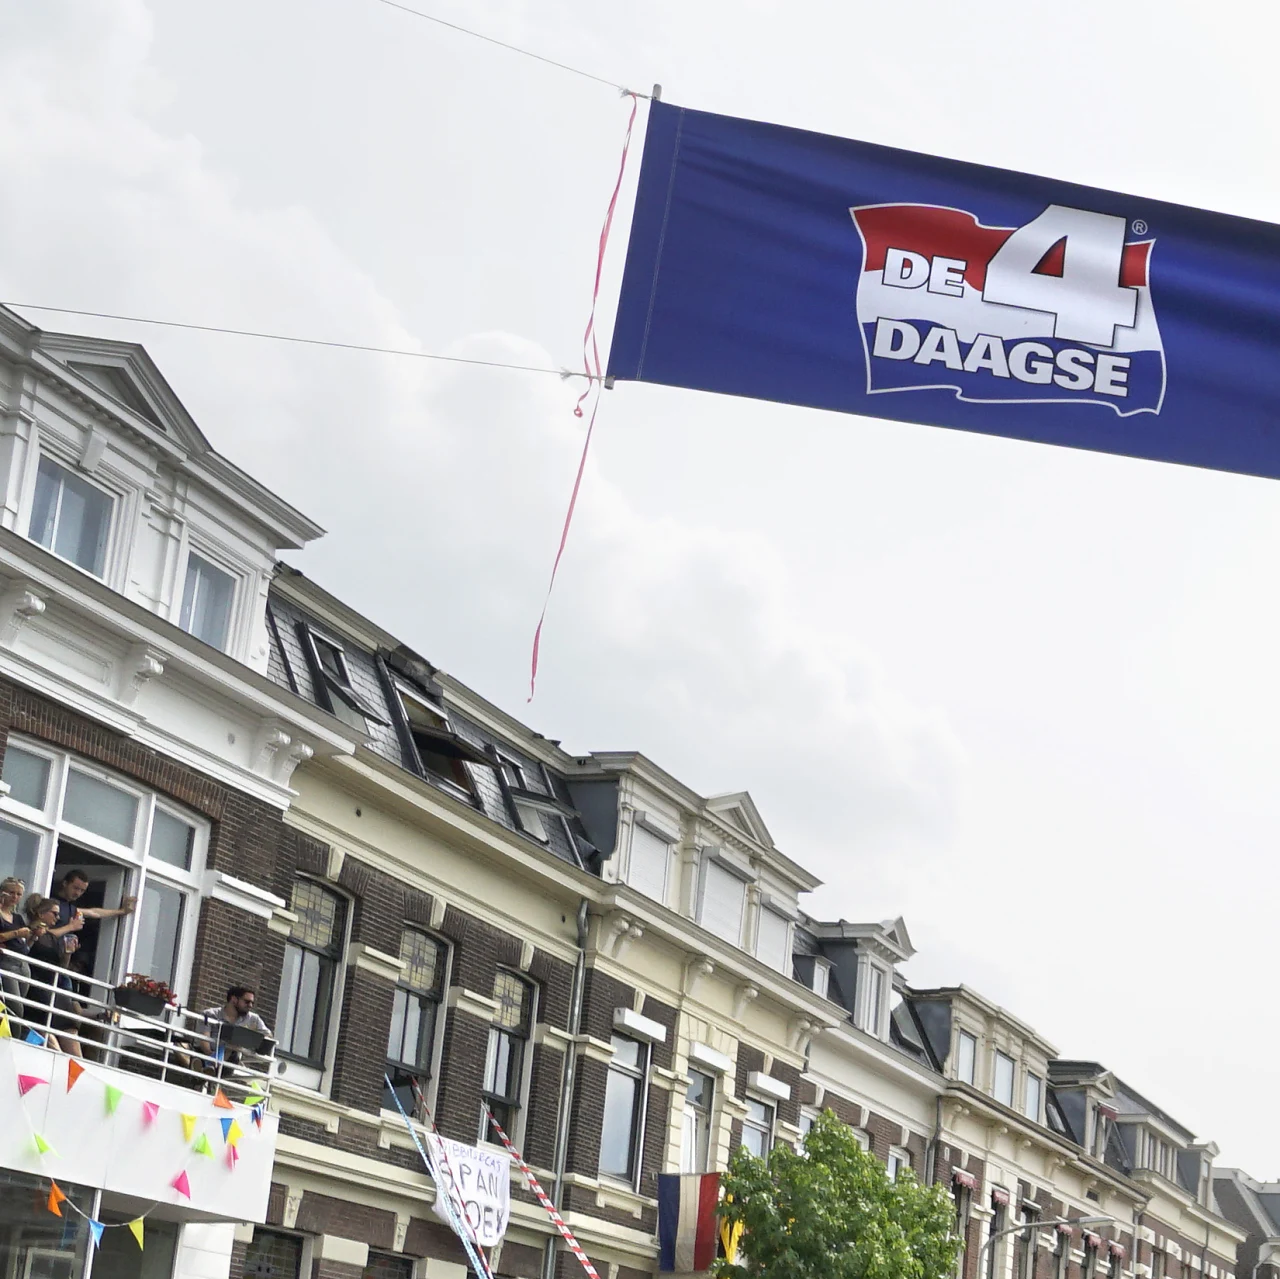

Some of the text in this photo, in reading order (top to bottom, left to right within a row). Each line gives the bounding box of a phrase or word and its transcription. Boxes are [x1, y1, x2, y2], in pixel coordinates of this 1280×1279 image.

[882, 204, 1138, 348] DE 4
[873, 317, 1131, 397] DAAGSE
